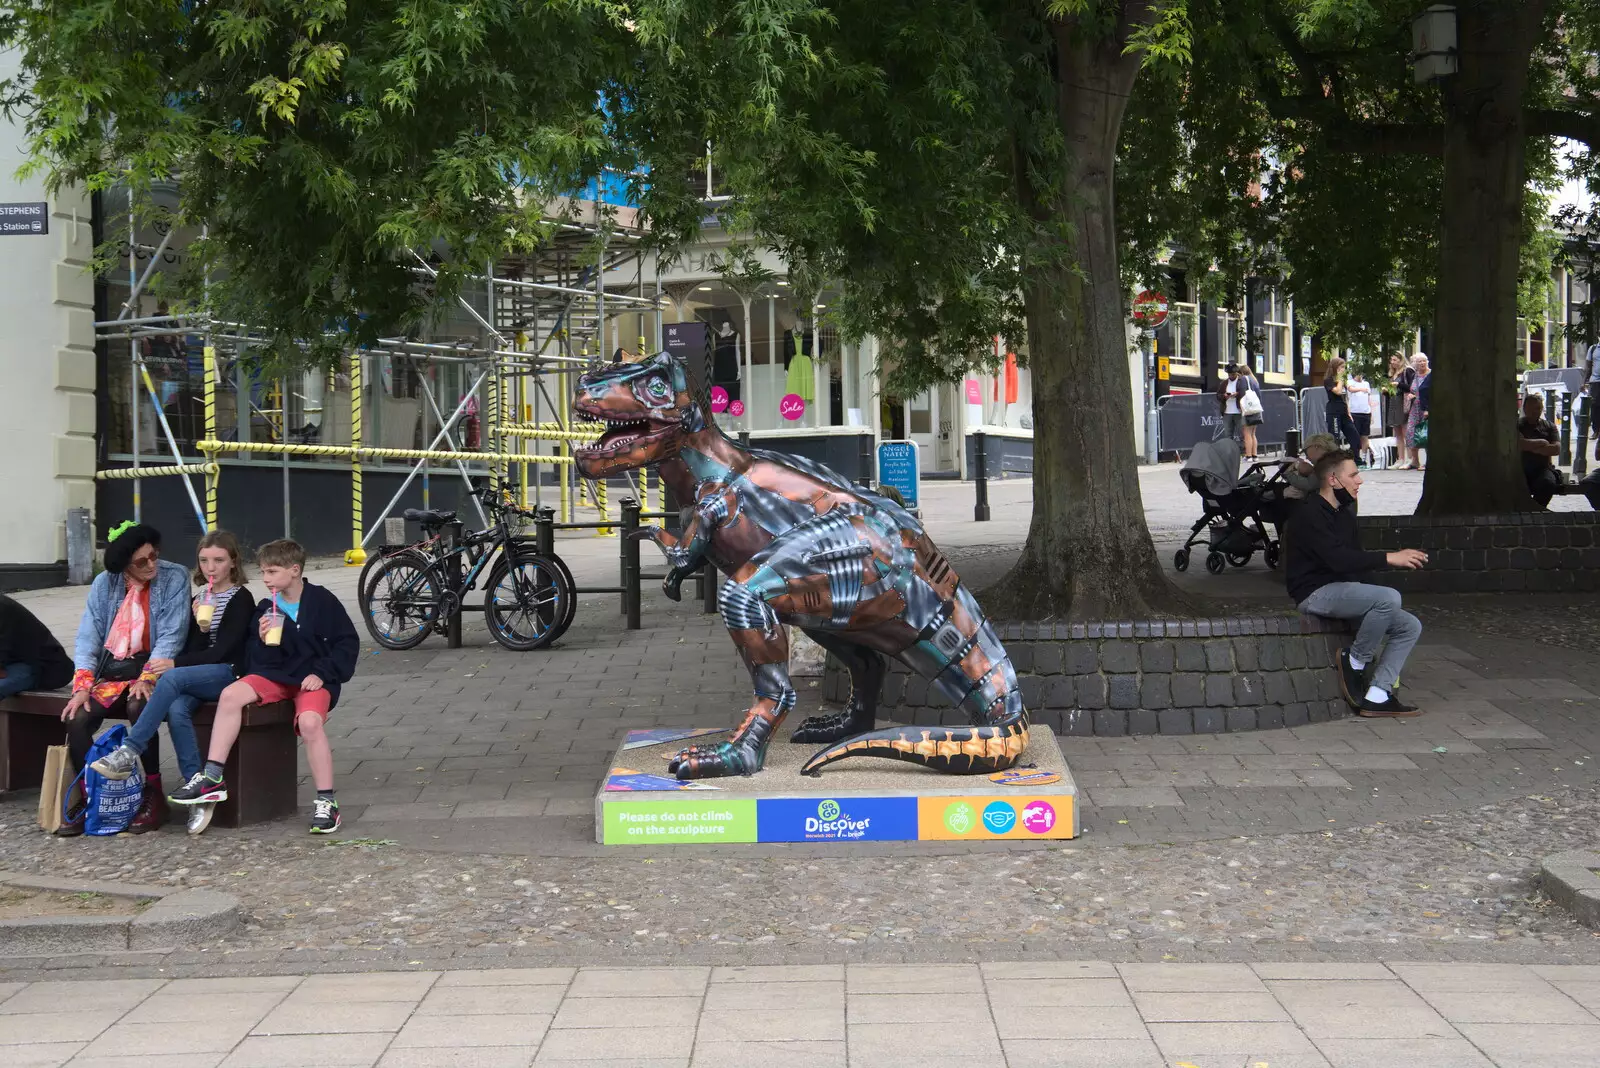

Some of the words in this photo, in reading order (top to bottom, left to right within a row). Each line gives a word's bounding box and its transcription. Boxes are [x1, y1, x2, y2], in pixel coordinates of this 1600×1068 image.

[0, 207, 40, 215] STEPHENS
[3, 223, 30, 231] Station
[712, 395, 727, 404] ale
[781, 401, 803, 414] Sale
[100, 796, 113, 806] THE
[99, 804, 130, 812] BEARERS
[619, 812, 658, 822] Please
[660, 811, 676, 821] do
[678, 811, 699, 821] not
[700, 810, 733, 821] climb
[627, 825, 643, 835] on
[645, 824, 665, 834] the
[668, 823, 725, 835] sculpture
